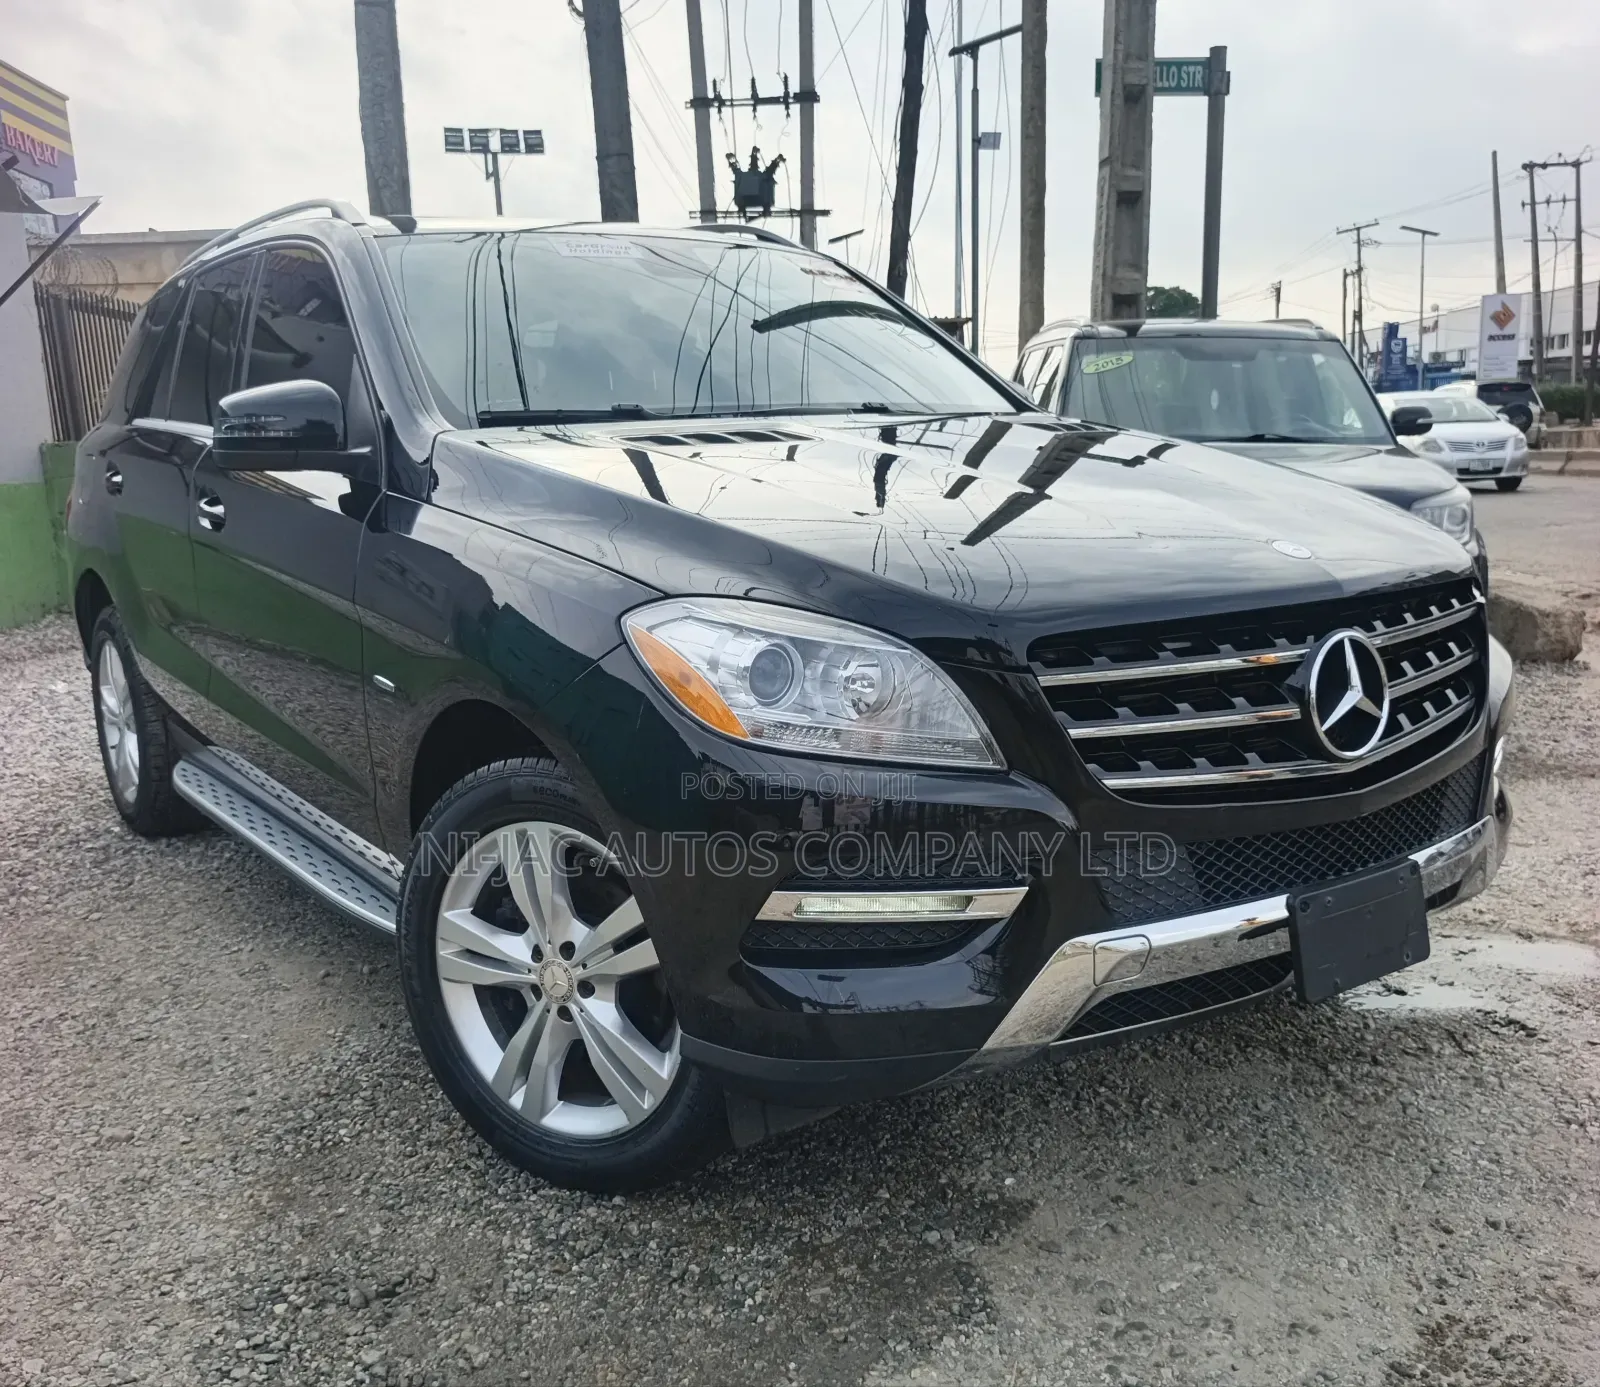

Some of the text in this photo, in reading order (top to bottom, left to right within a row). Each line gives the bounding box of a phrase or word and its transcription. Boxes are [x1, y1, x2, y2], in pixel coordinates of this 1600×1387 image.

[1153, 65, 1203, 88] LLO STR
[5, 124, 58, 166] BAKERY
[1094, 357, 1124, 371] 2015
